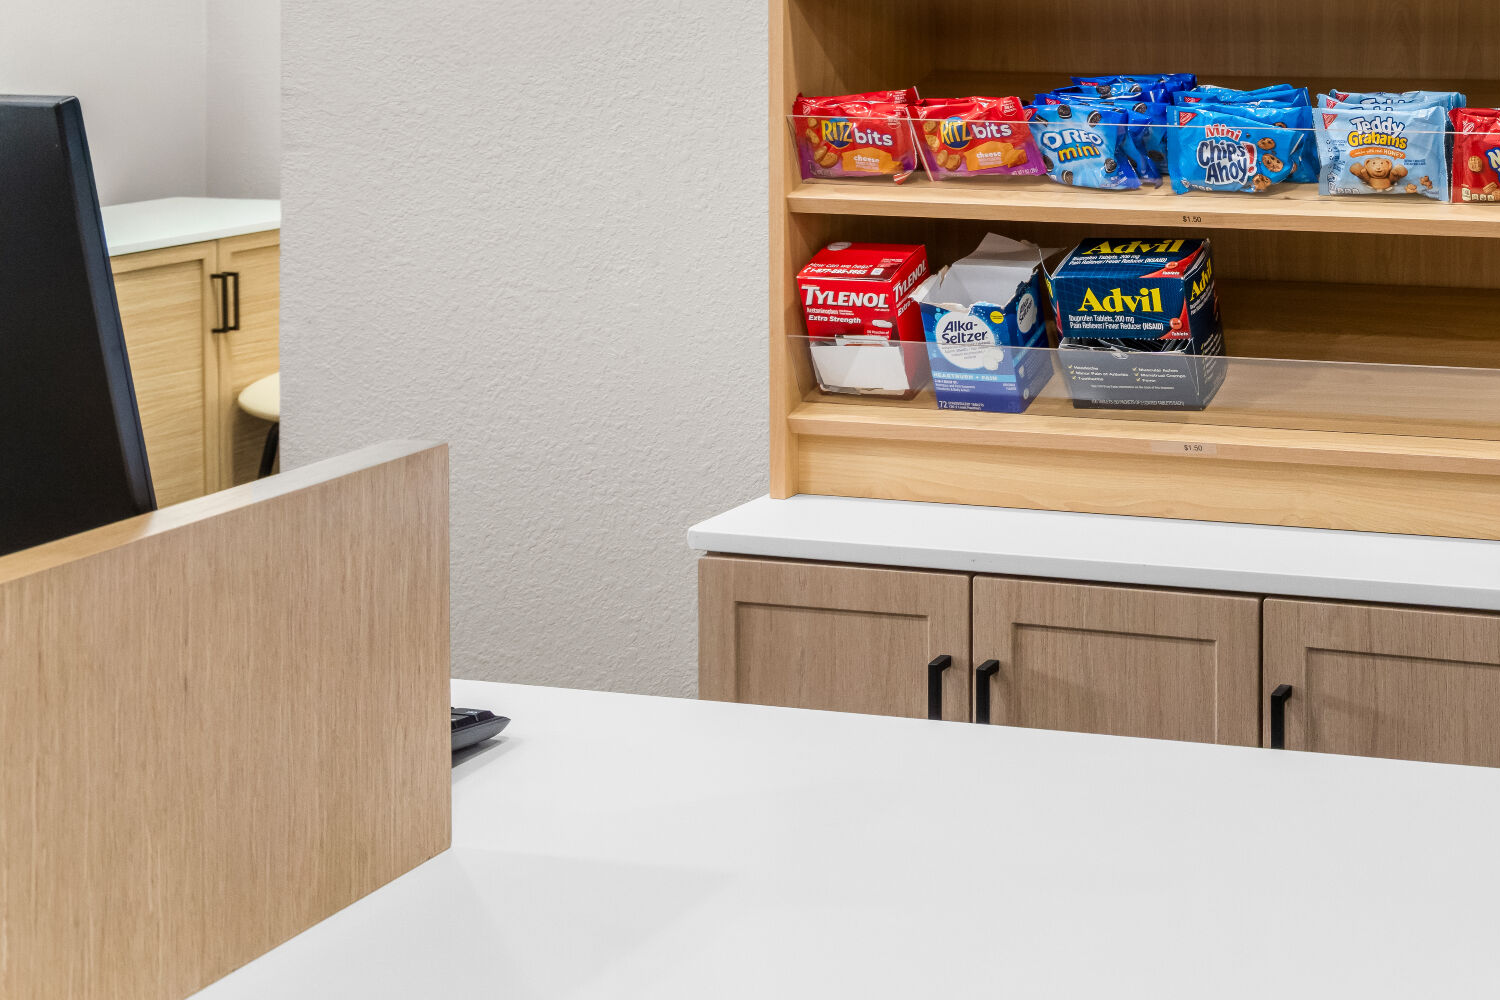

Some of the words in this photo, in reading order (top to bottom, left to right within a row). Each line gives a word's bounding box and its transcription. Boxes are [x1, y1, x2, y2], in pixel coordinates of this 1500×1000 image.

[821, 119, 854, 143] RITZ
[940, 121, 973, 144] RITZ
[972, 121, 1012, 140] bits
[1205, 124, 1242, 142] Mini
[1350, 116, 1405, 138] Teddy
[854, 128, 893, 146] bits
[1042, 128, 1102, 150] OREO
[1348, 131, 1408, 150] Grahams
[1058, 143, 1100, 162] mini
[1198, 140, 1247, 167] Chips
[1082, 239, 1185, 255] Advil
[893, 259, 927, 303] TYLENOL
[1190, 258, 1213, 302] Advil
[801, 285, 889, 309] TYLENOL
[1077, 287, 1164, 313] Advil
[808, 314, 829, 322] Extra
[829, 314, 862, 324] Strength
[942, 320, 979, 333] Alka-
[1125, 316, 1135, 324] mg
[941, 331, 988, 345] Seltzer
[938, 400, 949, 409] 72
[1184, 444, 1203, 452] $1.50
